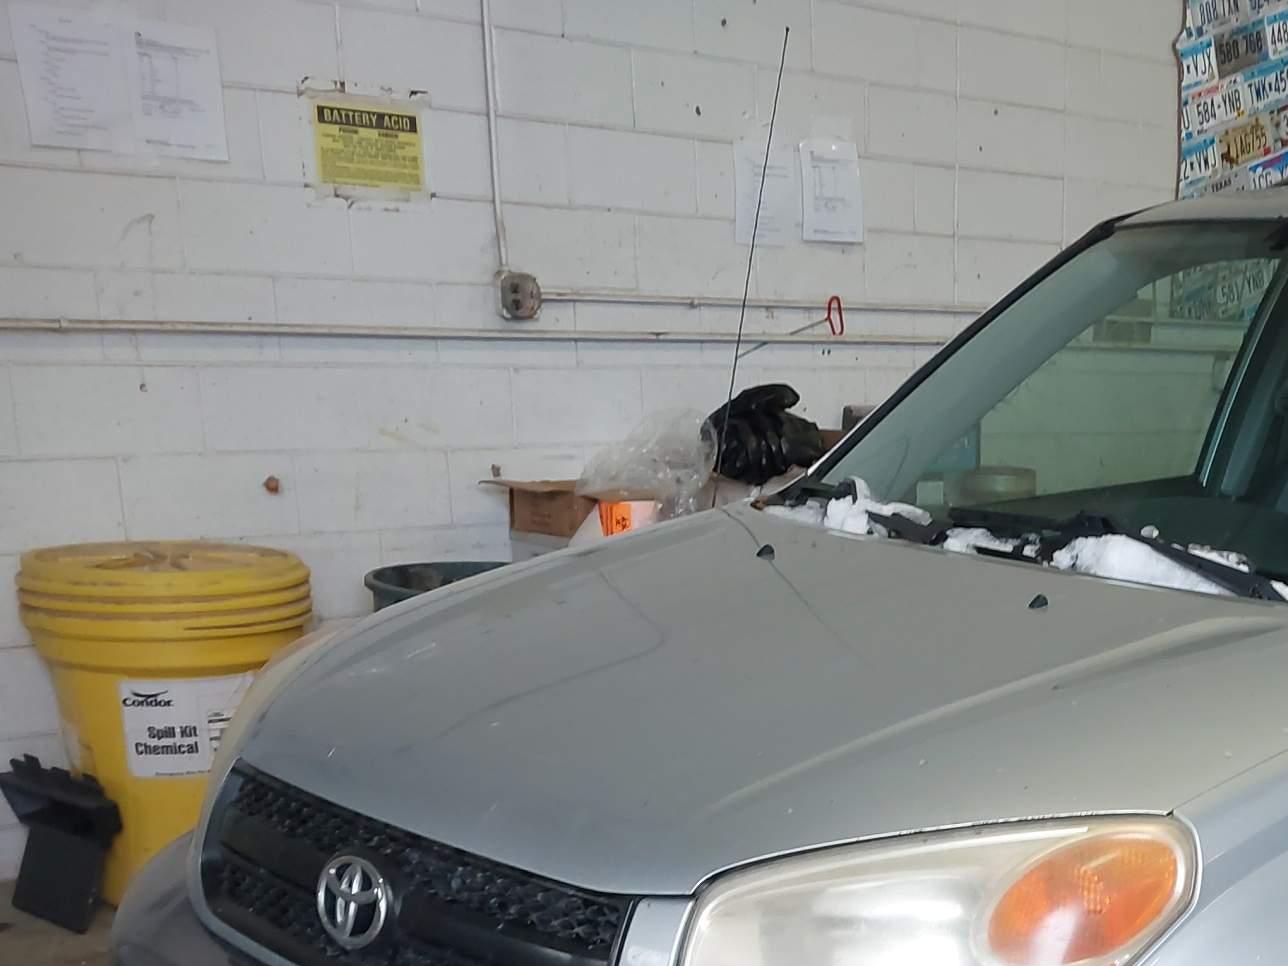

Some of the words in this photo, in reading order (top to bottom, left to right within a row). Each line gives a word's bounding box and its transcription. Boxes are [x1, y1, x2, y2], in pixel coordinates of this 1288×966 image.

[1270, 21, 1288, 47] 448
[323, 108, 377, 127] BATTERY
[383, 115, 410, 131] ACID
[122, 696, 173, 708] Condor
[147, 726, 176, 741] Spill
[180, 725, 198, 739] Kit
[134, 741, 199, 755] Chemical
